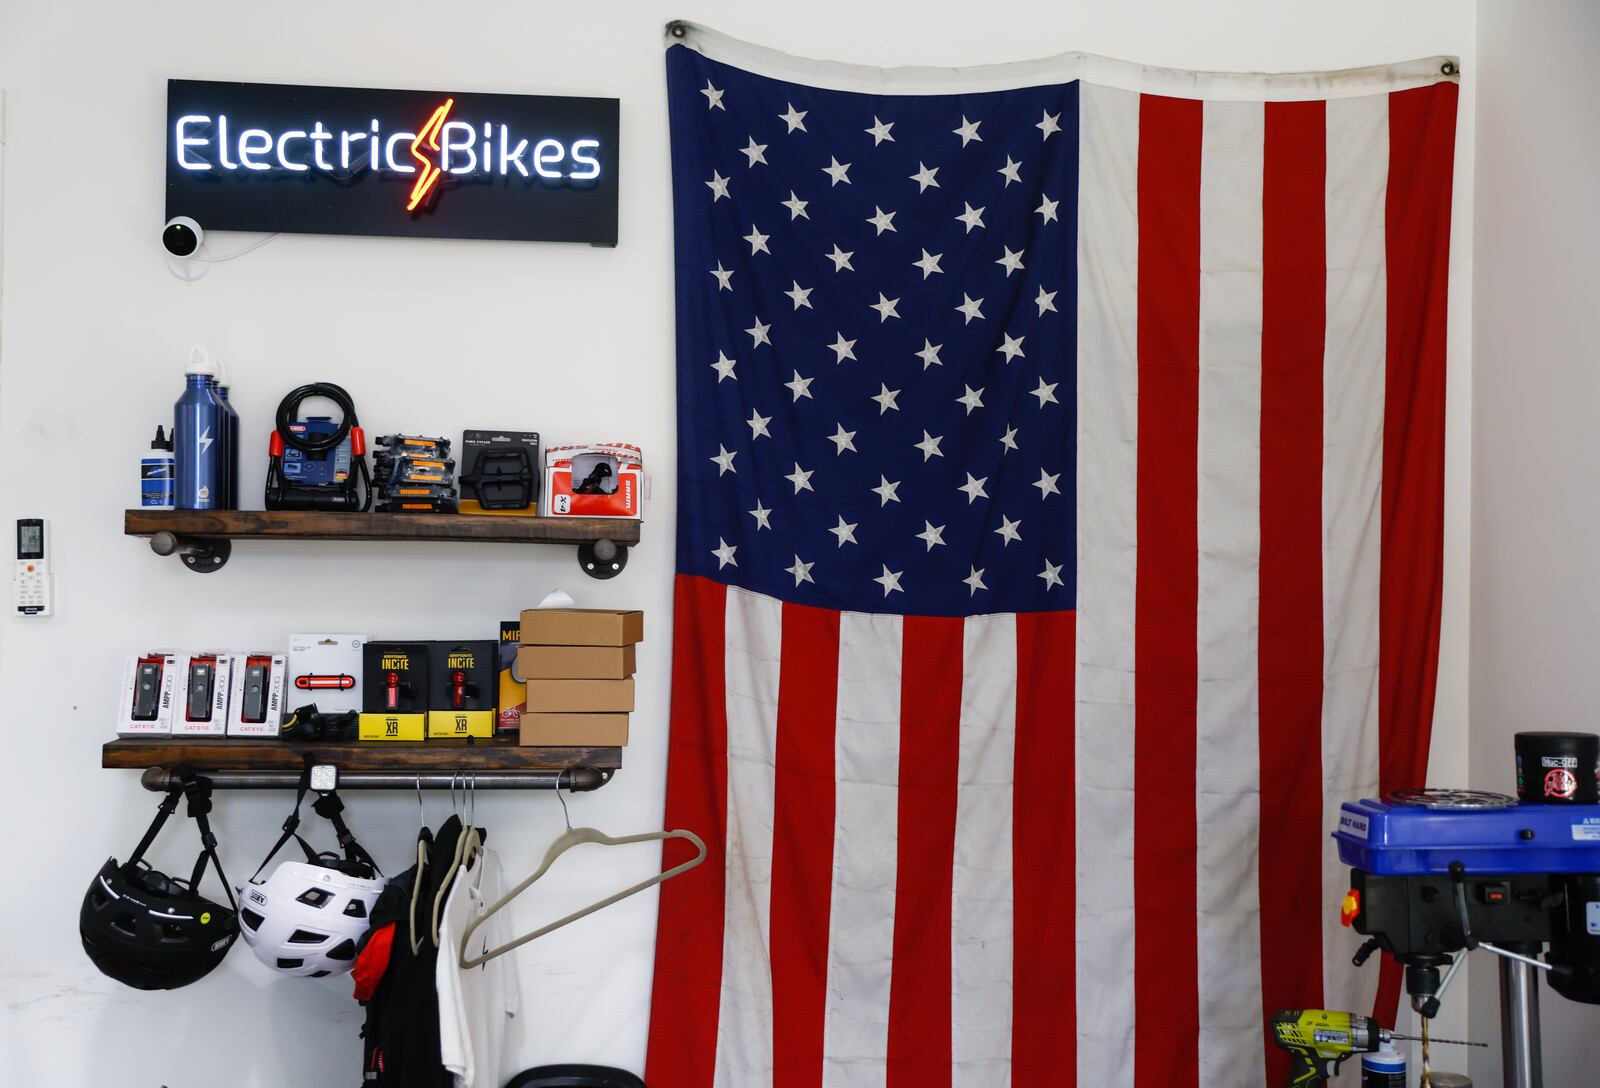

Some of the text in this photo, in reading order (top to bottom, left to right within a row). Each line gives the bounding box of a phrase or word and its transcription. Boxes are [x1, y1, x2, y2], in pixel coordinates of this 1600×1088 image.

[175, 115, 602, 181] Electric Bikes
[386, 721, 398, 734] XR
[455, 718, 467, 731] XR
